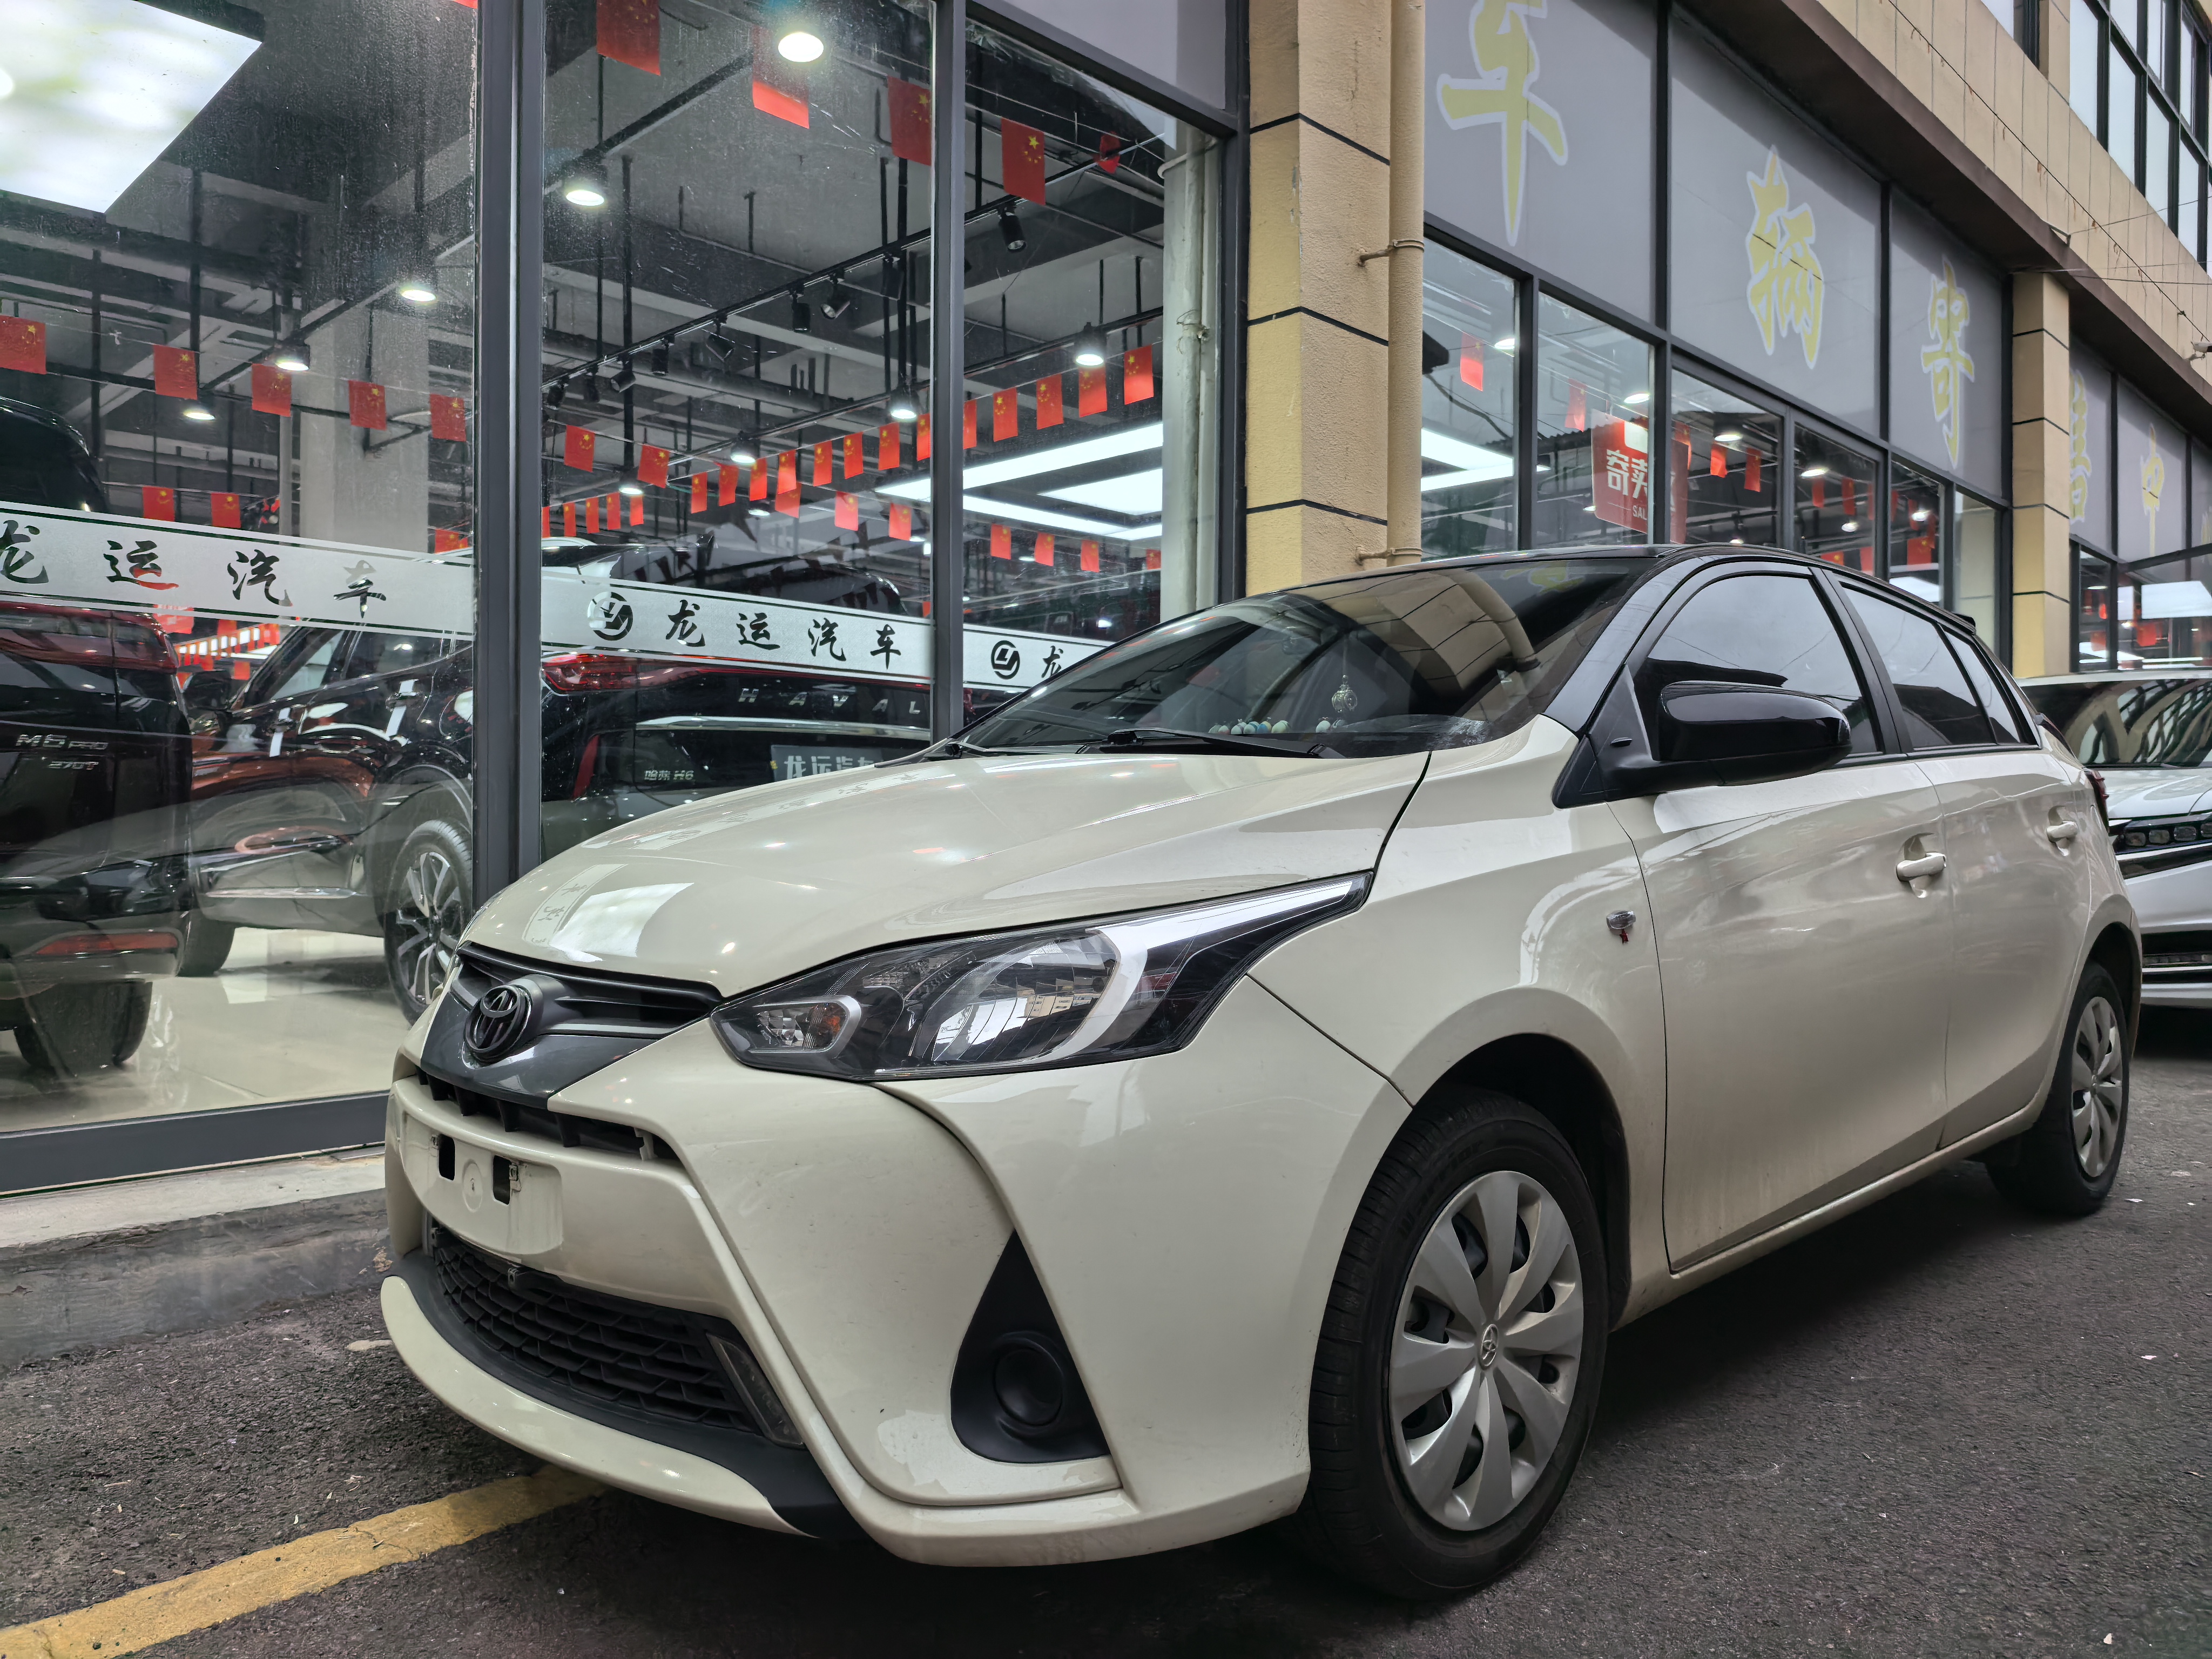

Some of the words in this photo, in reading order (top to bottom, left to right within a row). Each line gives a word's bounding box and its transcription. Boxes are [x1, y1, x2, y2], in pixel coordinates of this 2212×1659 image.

[1633, 505, 1648, 520] SAL
[0, 520, 387, 619] 龙运汽车
[665, 599, 902, 670] 龙运汽车
[738, 687, 920, 714] HAVAL
[673, 770, 694, 780] H6
